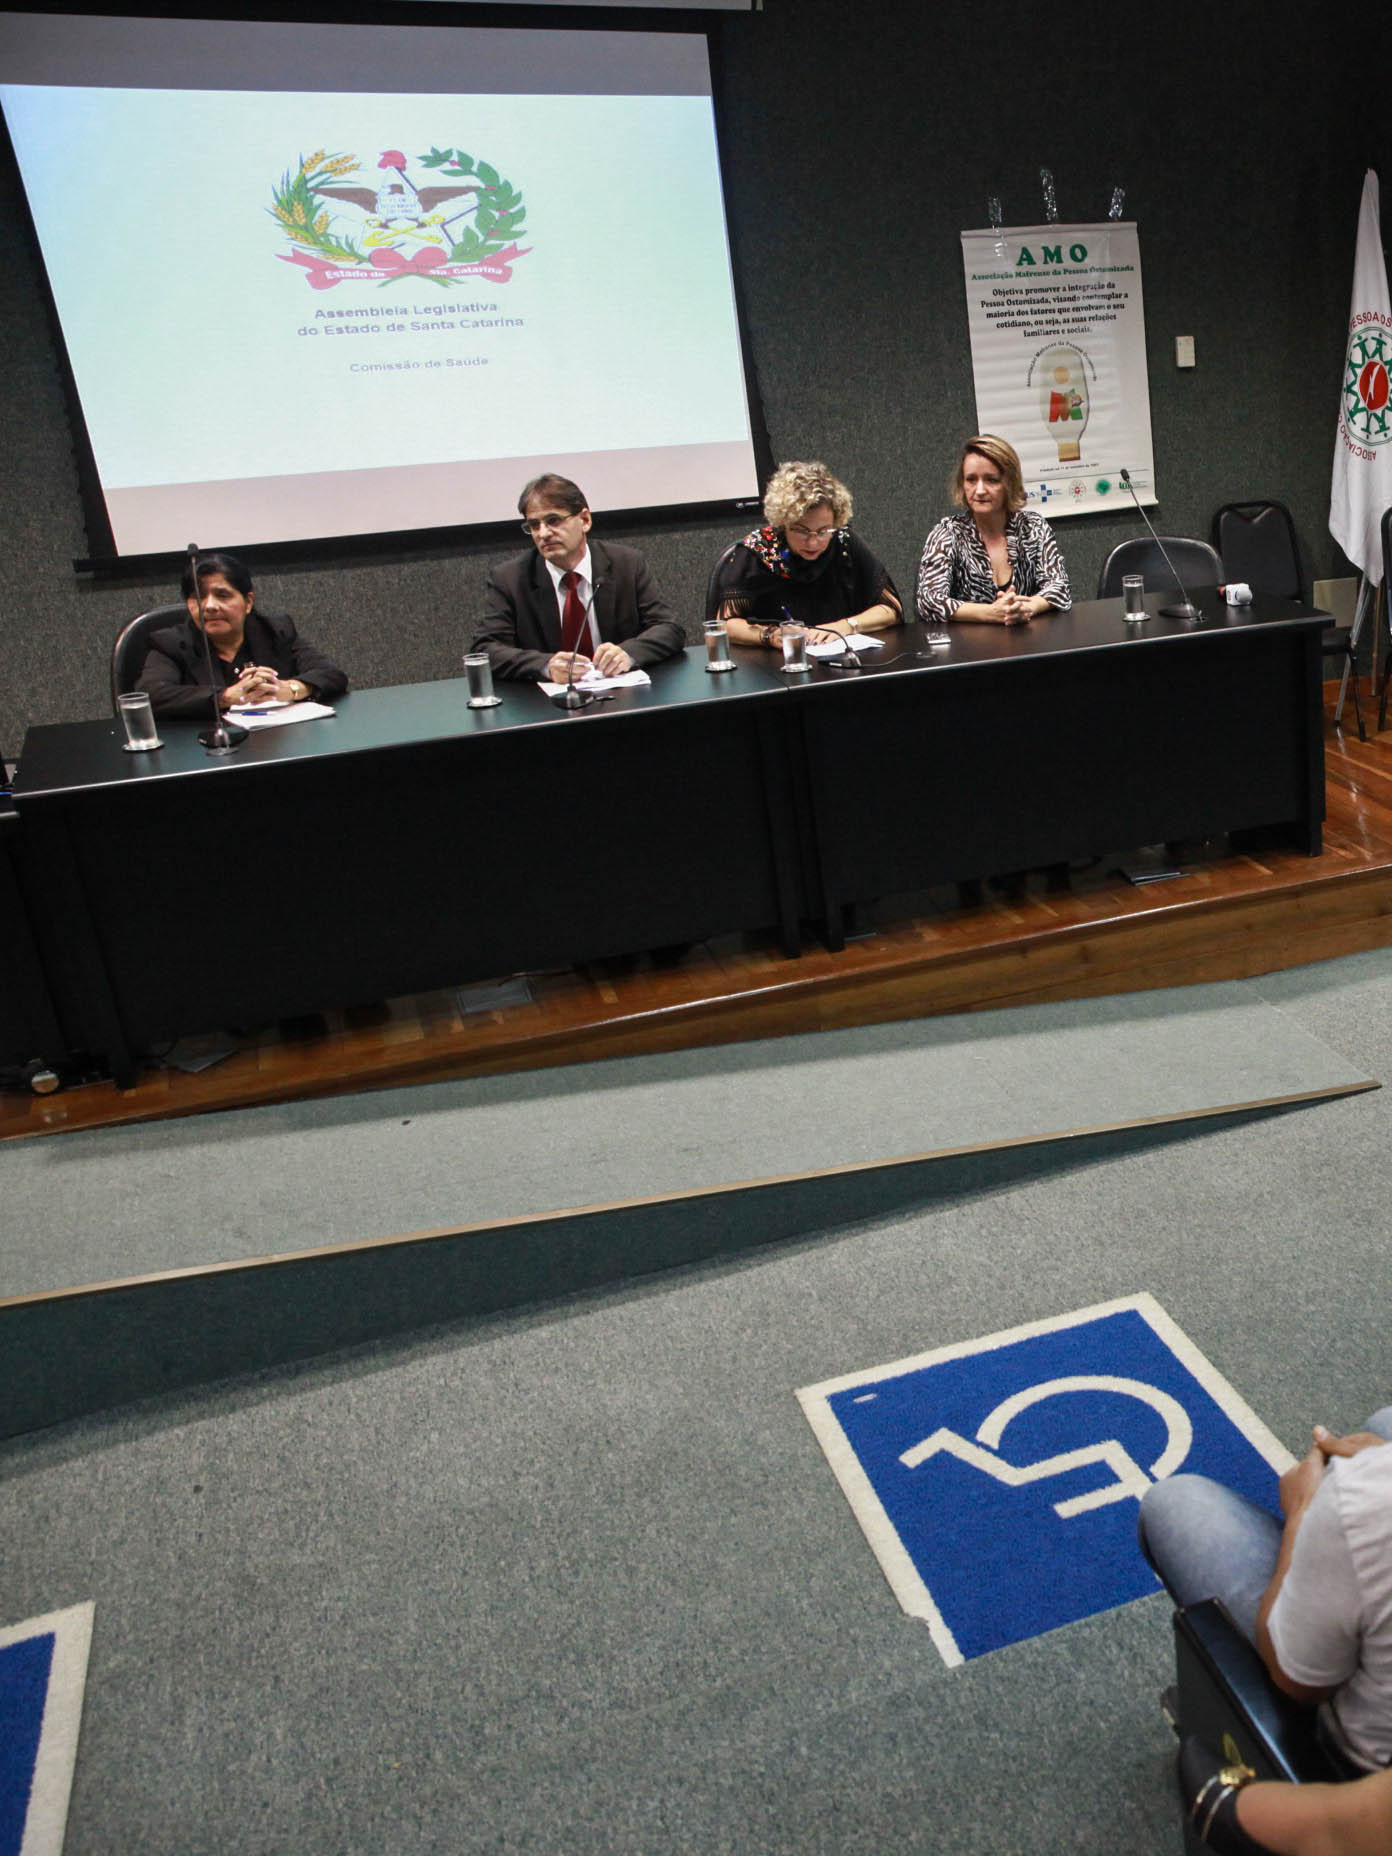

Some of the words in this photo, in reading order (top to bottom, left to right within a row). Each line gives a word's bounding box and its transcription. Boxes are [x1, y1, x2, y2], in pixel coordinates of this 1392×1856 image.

[1016, 243, 1088, 266] AMO
[325, 268, 368, 280] Estado
[453, 265, 504, 276] Catarina
[1052, 268, 1062, 276] da
[1063, 267, 1089, 275] Pessoa
[992, 288, 1024, 298] Objetiva
[1025, 287, 1060, 296] promover
[1068, 282, 1105, 292] integração
[1106, 281, 1115, 289] da
[314, 305, 408, 319] Assembleia
[413, 302, 498, 317] Legislativa
[981, 300, 1005, 308] Pessoa
[986, 309, 1015, 319] maioria
[1016, 308, 1029, 317] dos
[1030, 307, 1056, 316] fatores
[1057, 306, 1071, 315] que
[1112, 302, 1125, 310] seu
[297, 323, 319, 337] do
[324, 321, 382, 337] Estado
[386, 320, 406, 333] de
[410, 318, 456, 333] Santa
[459, 316, 524, 329] Catarina
[1034, 318, 1044, 326] ou
[1071, 315, 1087, 324] suas
[1088, 313, 1117, 322] relações
[1352, 312, 1379, 328] ESSOA
[1023, 327, 1060, 338] familiares
[349, 359, 420, 374] Comissão
[423, 357, 441, 370] de
[446, 355, 489, 368] Saúde
